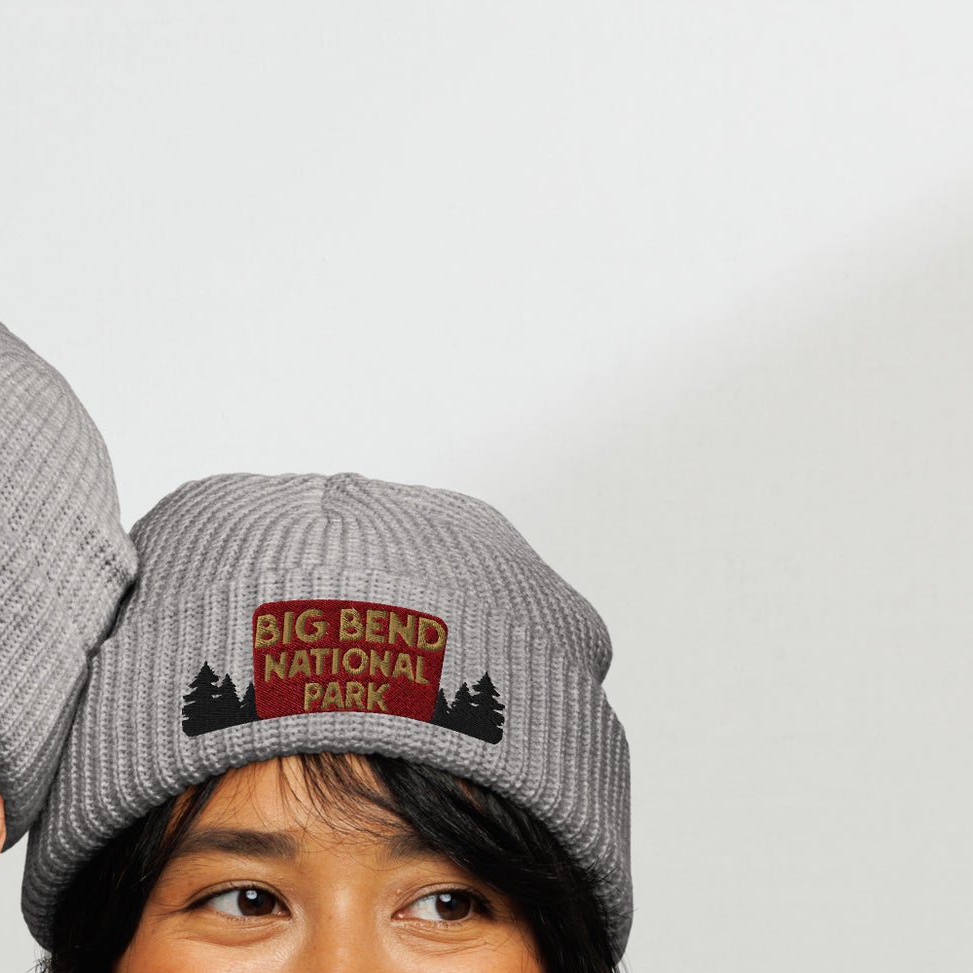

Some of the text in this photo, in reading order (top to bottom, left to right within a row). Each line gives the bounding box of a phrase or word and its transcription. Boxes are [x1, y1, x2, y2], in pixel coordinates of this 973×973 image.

[255, 608, 446, 651] BIG BEND
[264, 648, 429, 684] NATIONAL
[304, 681, 389, 711] PARK
